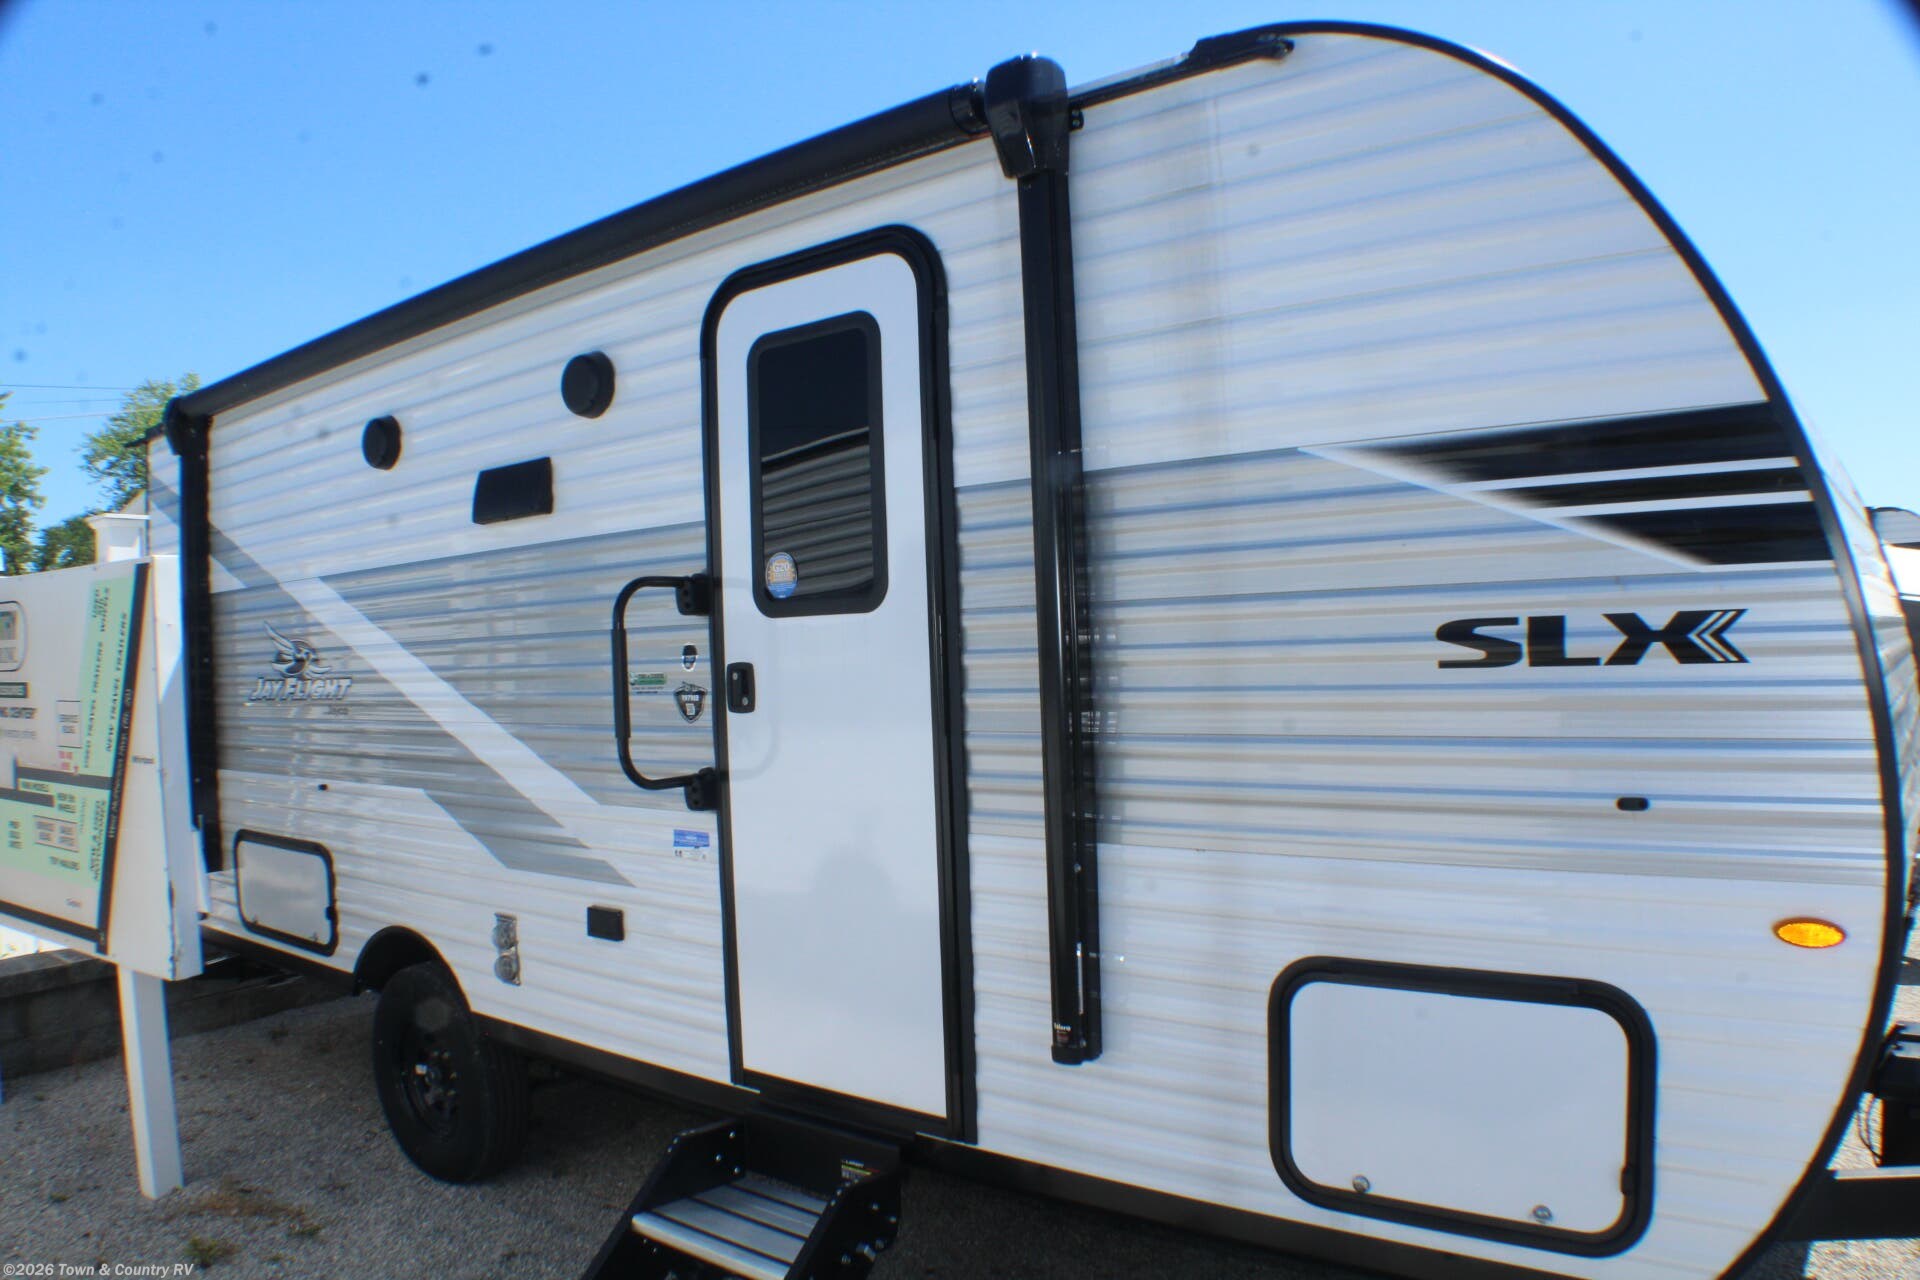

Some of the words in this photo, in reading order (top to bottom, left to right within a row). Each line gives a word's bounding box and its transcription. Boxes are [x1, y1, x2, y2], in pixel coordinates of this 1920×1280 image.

[1436, 609, 1750, 668] SLX
[106, 725, 114, 752] NEW
[110, 678, 121, 720] TRAVEL
[116, 612, 127, 671] TRAILERS
[248, 677, 284, 701] JAY
[281, 677, 352, 701] FLIGHT
